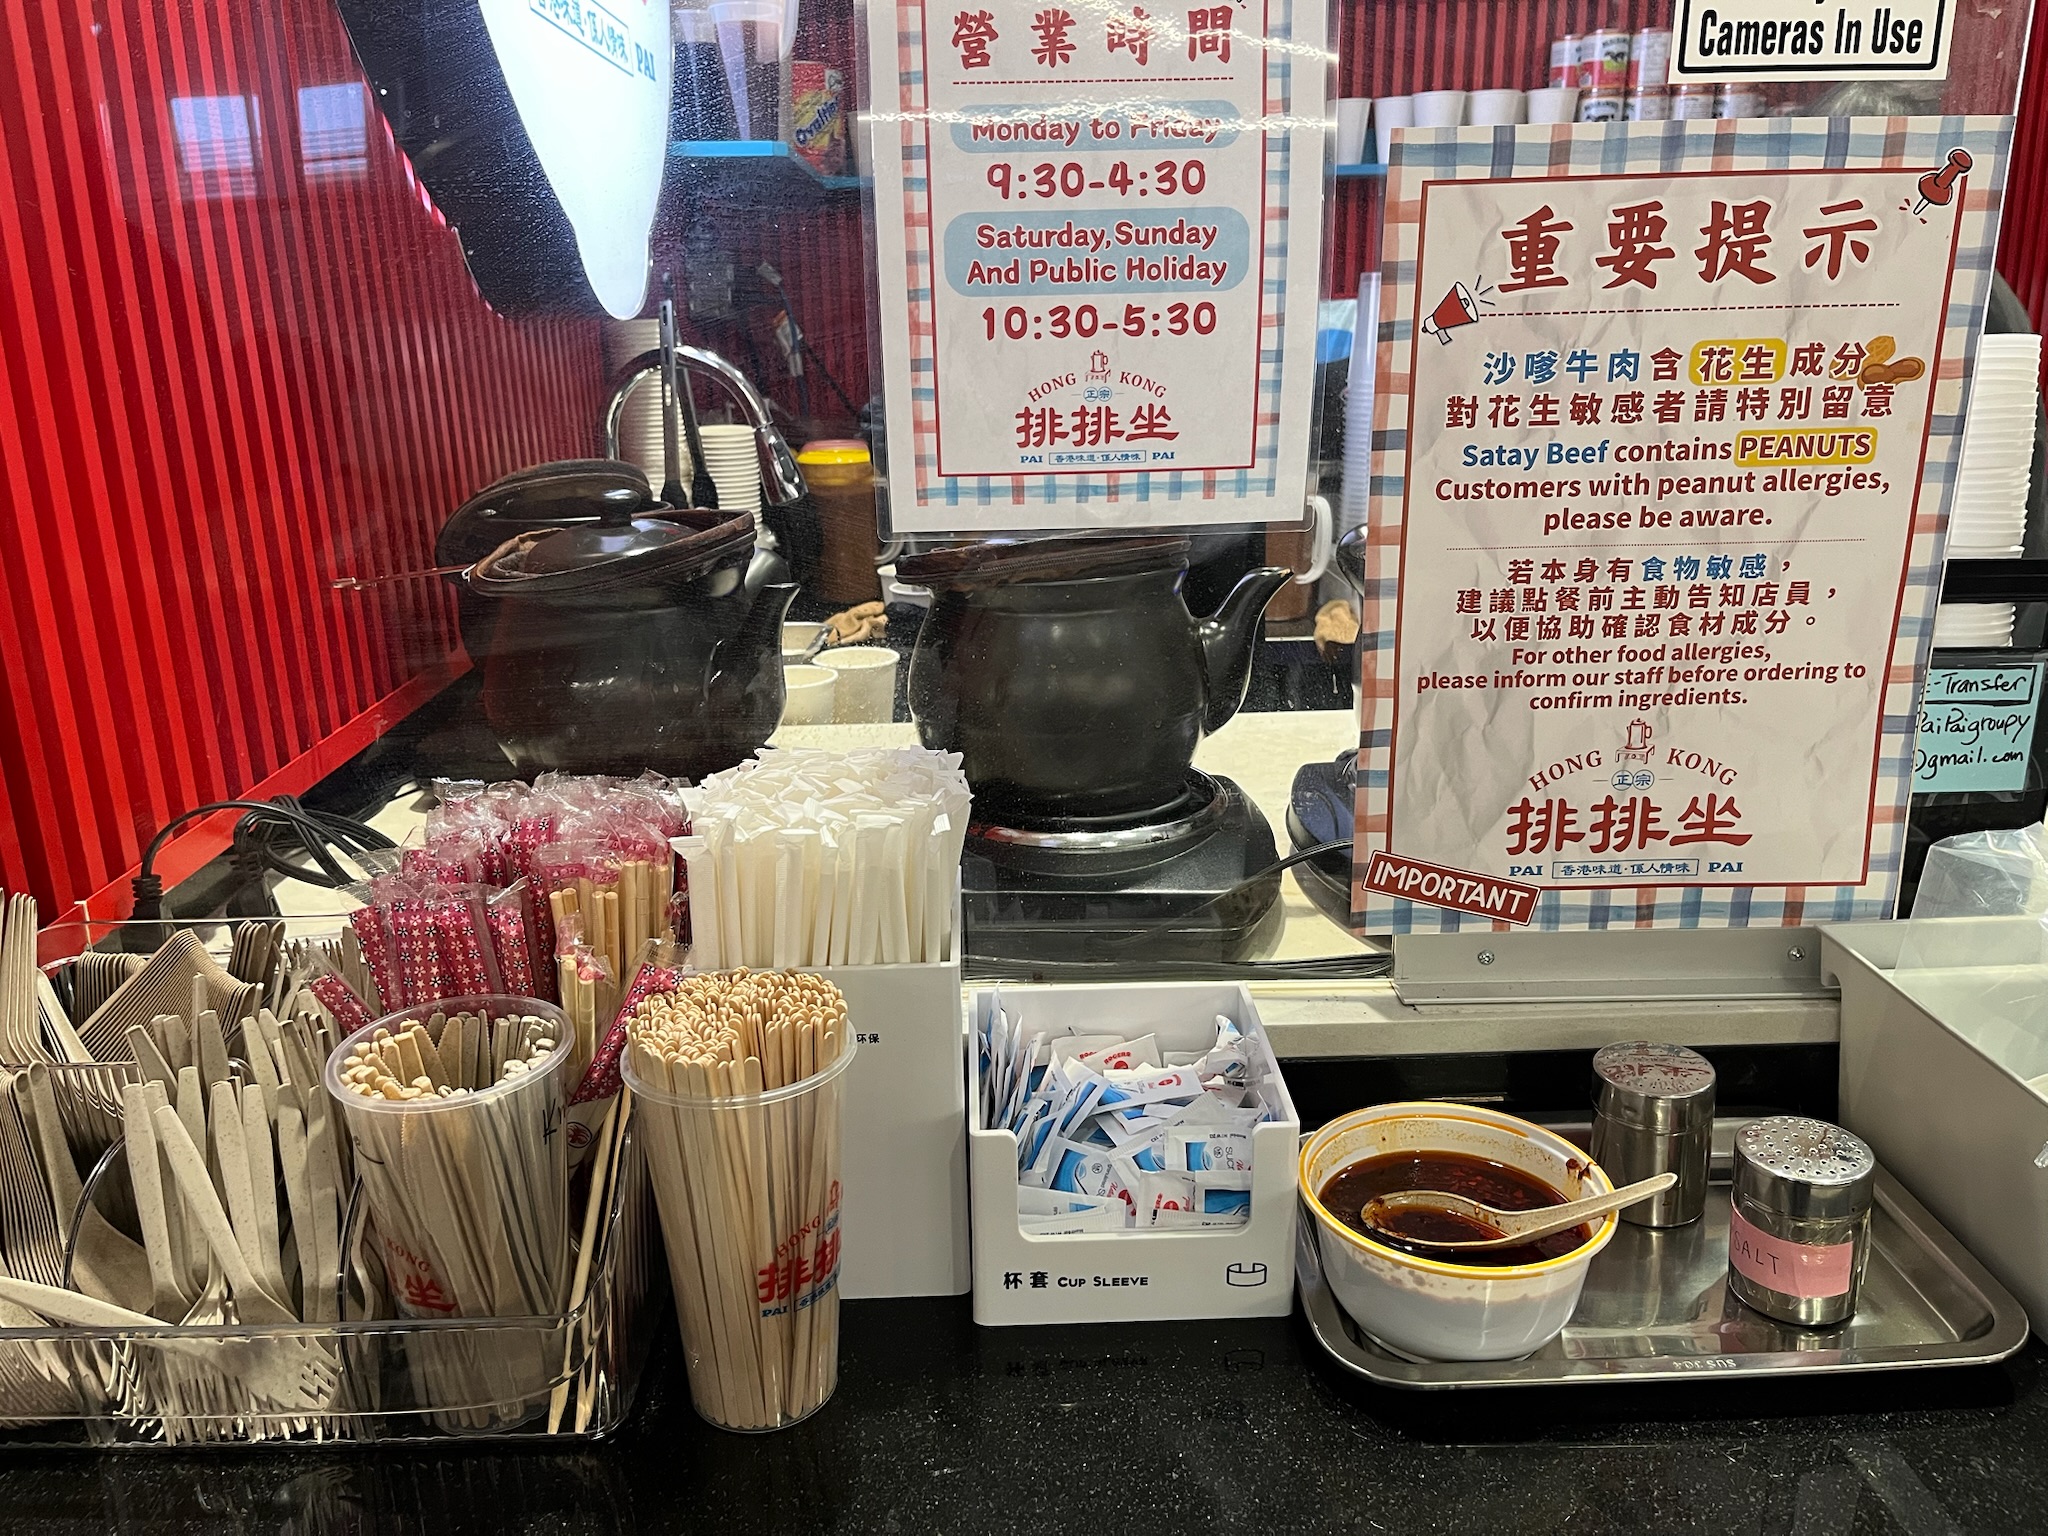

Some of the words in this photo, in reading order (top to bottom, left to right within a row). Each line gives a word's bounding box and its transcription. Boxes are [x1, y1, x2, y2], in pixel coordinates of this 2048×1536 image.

[951, 4, 1234, 71] 營業時間
[1698, 9, 1825, 57] Cameras
[1834, 8, 1862, 54] In
[1871, 7, 1923, 54] Use
[635, 42, 657, 82] PAI
[972, 113, 1080, 147] Monday
[1088, 117, 1121, 140] to
[987, 159, 1206, 200] 9:30-4:30
[1497, 199, 1878, 294] 重要提示
[967, 258, 1020, 285] And
[1030, 257, 1117, 284] Public
[1126, 254, 1227, 286] Holiday
[982, 301, 1217, 341] 10:30-5:30
[1482, 341, 1868, 386] 沙嗲牛肉含花生成分
[1027, 372, 1076, 403] HONG
[1119, 371, 1167, 398] KONG
[1086, 389, 1110, 399] 正宗
[1445, 382, 1895, 429] 對花生敏感者請特別留意
[1014, 402, 1180, 449] 排排坐
[1020, 455, 1043, 464] PAI
[1152, 451, 1175, 460] PAI
[1462, 444, 1540, 471] Satay
[1546, 439, 1610, 465] Beef
[1614, 436, 1733, 463] contains
[1737, 431, 1874, 461] PEANUTS
[1435, 478, 1582, 501] Customers
[1588, 472, 1650, 497] with
[1657, 471, 1756, 501] peanut
[1762, 465, 1890, 497] allergies,
[1543, 507, 1632, 536] please
[1639, 505, 1673, 529] be
[1679, 508, 1773, 528] aware.
[1506, 554, 1791, 585] 若本身有食物敏感，
[1455, 581, 1836, 614] 建議點餐前主動告知店員，
[1470, 610, 1816, 642] 以便協助確認食材成分。
[1512, 648, 1548, 666] For
[1552, 645, 1613, 665] other
[1617, 643, 1667, 663] food
[1671, 640, 1771, 665] allergies,
[1417, 671, 1488, 694] please
[1493, 669, 1566, 689] inform
[1572, 672, 1611, 687] our
[1613, 665, 1665, 685] staff
[1667, 664, 1738, 684] before
[1743, 661, 1840, 684] ordering
[1844, 662, 1866, 679] to
[1529, 691, 1613, 710] confirm
[1618, 688, 1748, 711] ingredients.
[1528, 750, 1603, 793] HONG
[1666, 747, 1738, 786] KONG
[1614, 773, 1651, 787] 正宗
[1505, 792, 1753, 856] 排排坐
[1508, 865, 1544, 877] PAI
[1707, 862, 1744, 873] PAI
[1373, 860, 1530, 915] IMPORTANT
[775, 1215, 822, 1258] HONG
[1732, 1229, 1780, 1275] SALT
[1003, 1270, 1049, 1290] 杯套
[761, 1305, 788, 1318] PAI
